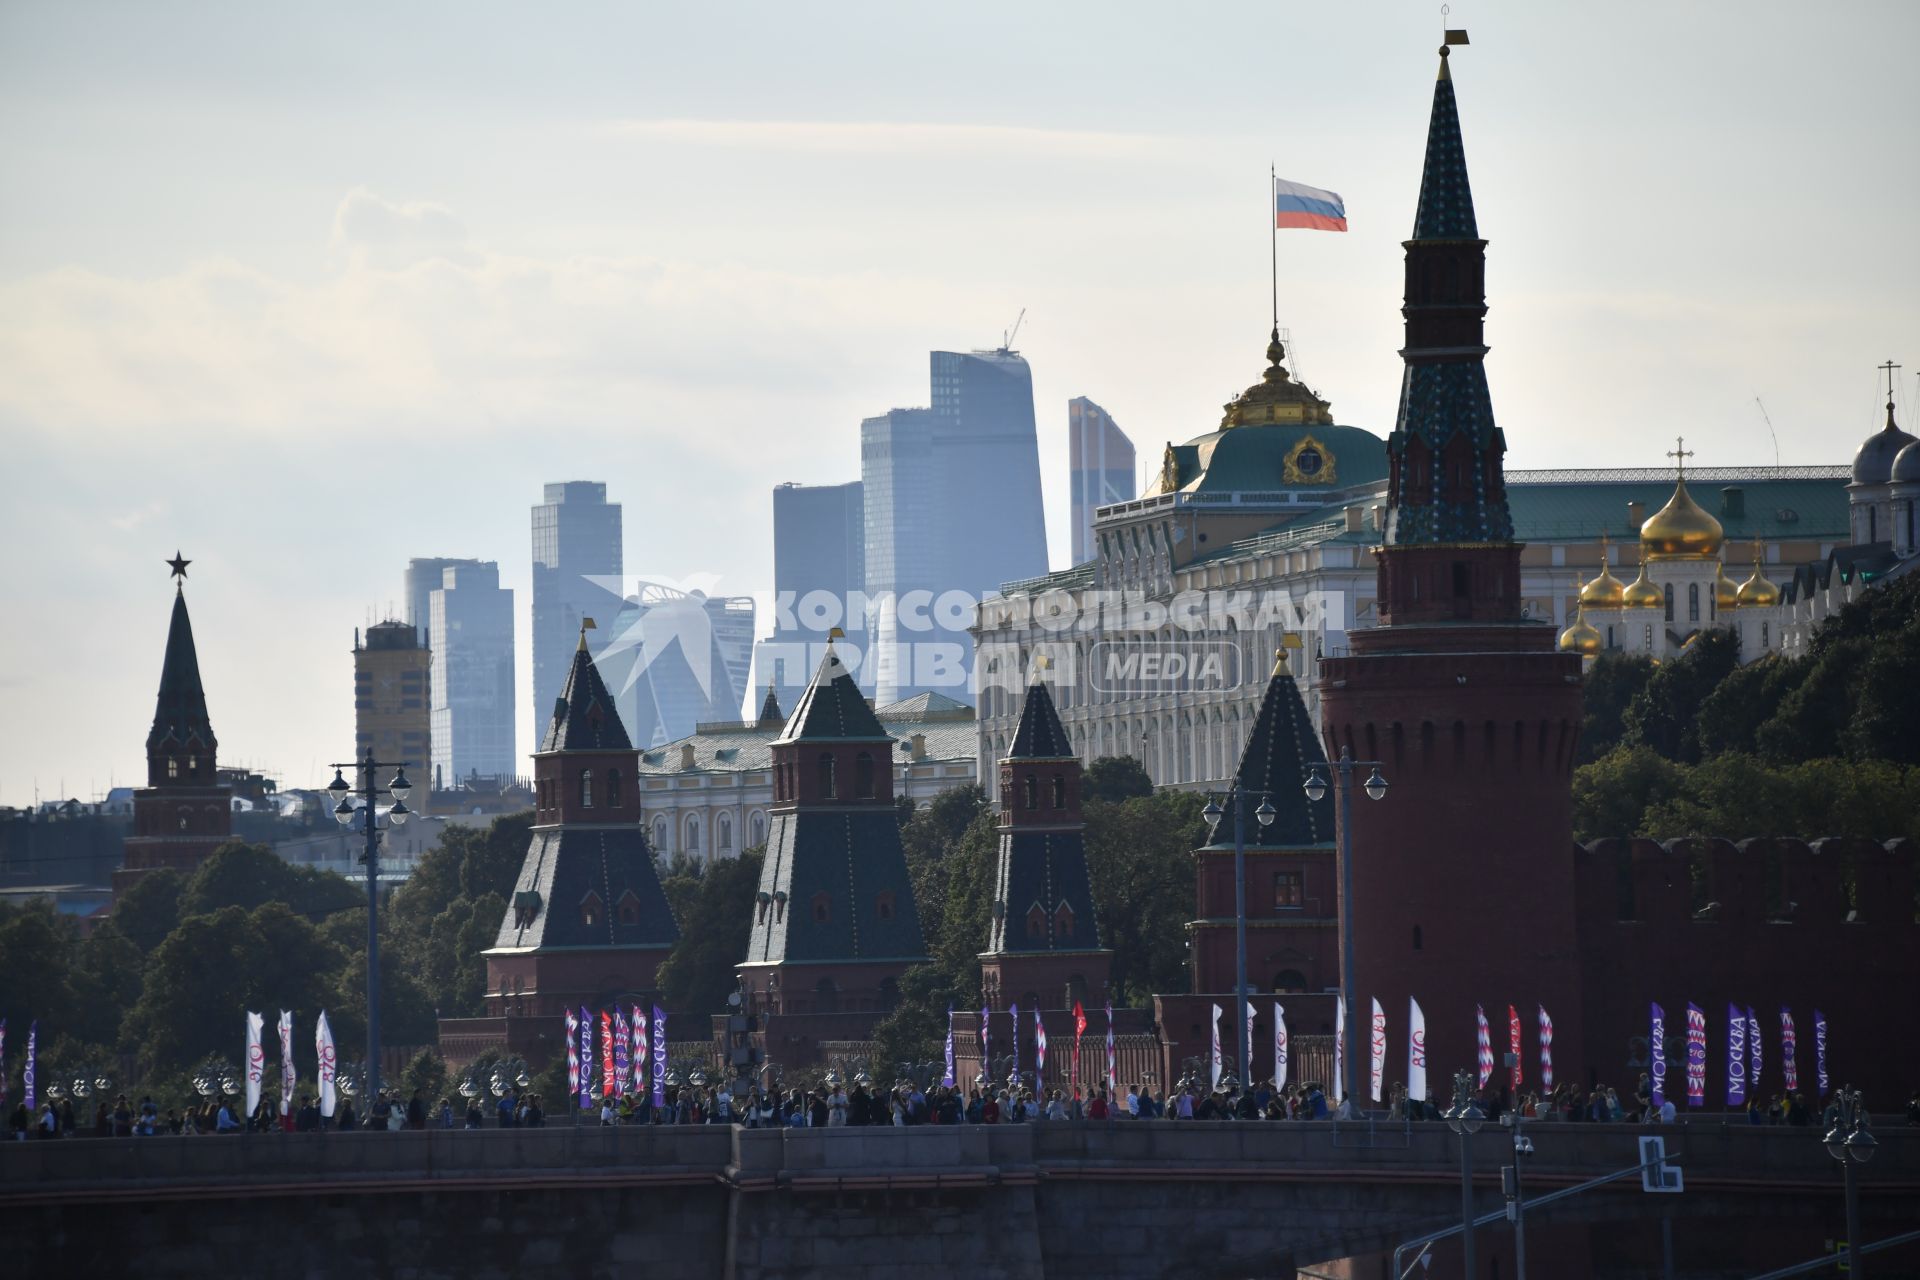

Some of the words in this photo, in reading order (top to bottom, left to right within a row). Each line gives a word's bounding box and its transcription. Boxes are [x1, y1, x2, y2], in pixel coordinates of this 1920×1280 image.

[653, 1019, 666, 1094] МОСКВА
[1411, 1030, 1426, 1068] 870
[1653, 1018, 1666, 1093] МОСКВА
[1729, 1017, 1745, 1094] МОСКВА
[1749, 1018, 1762, 1085] МОСКВА
